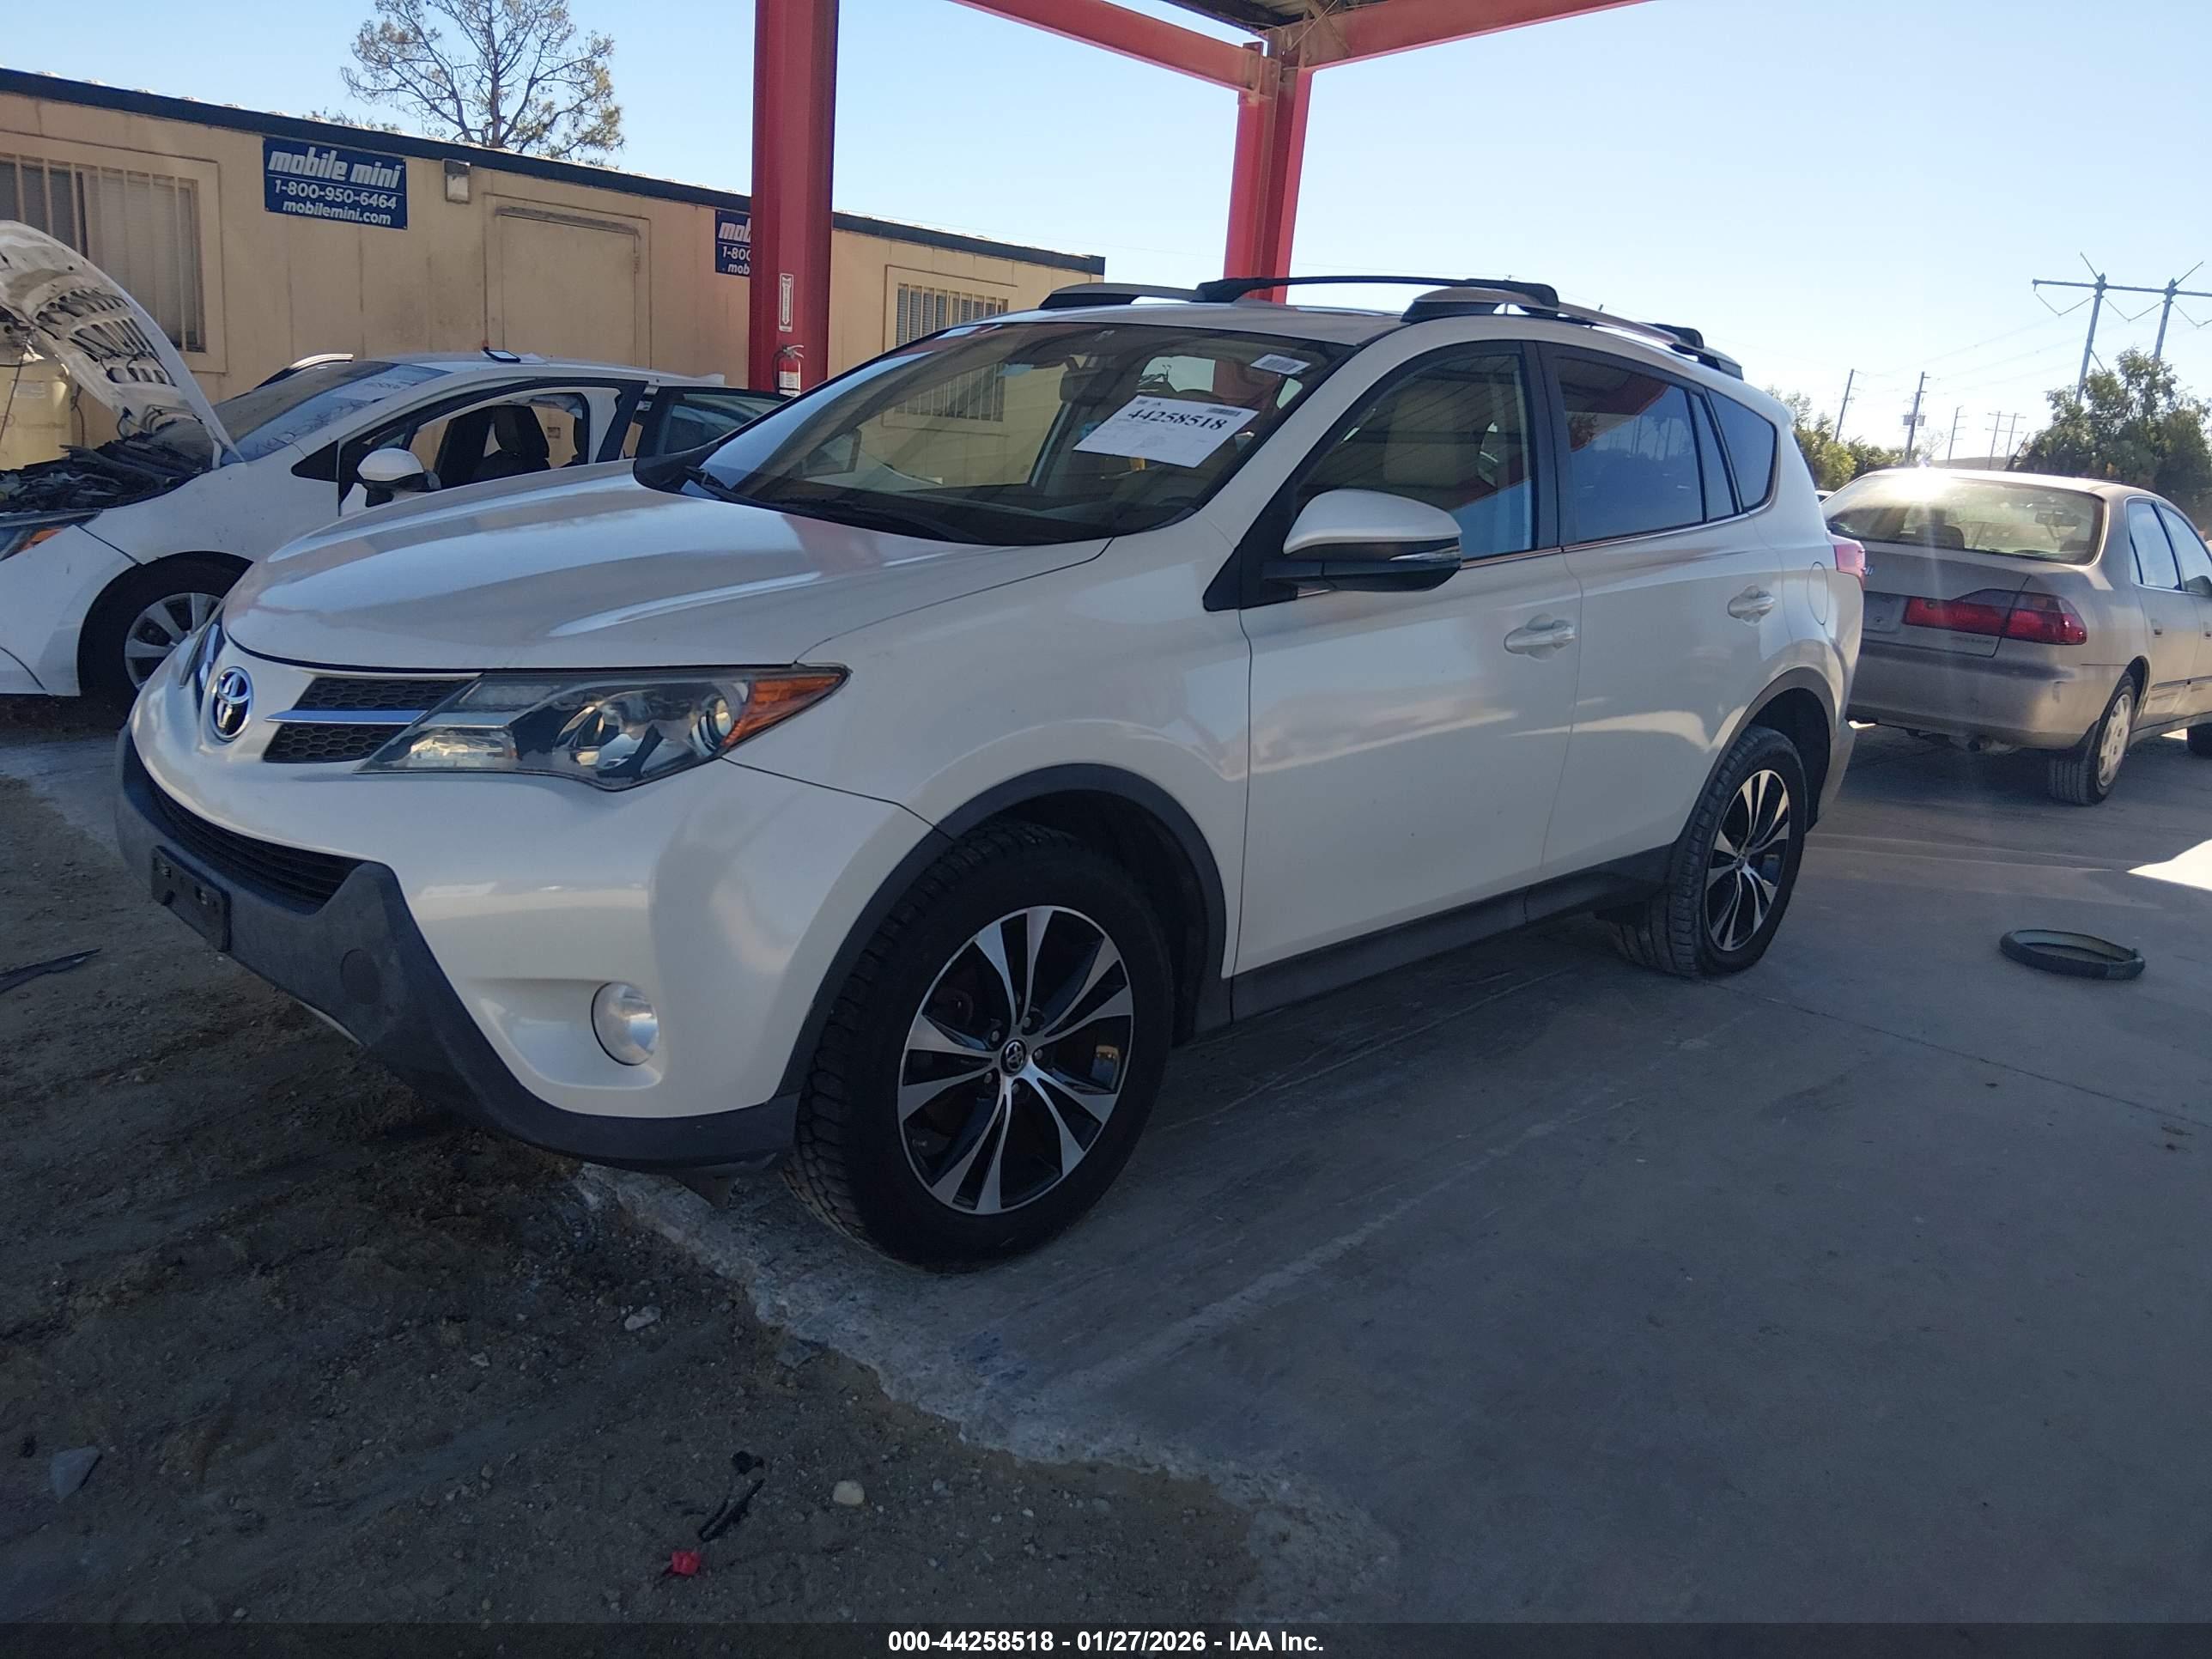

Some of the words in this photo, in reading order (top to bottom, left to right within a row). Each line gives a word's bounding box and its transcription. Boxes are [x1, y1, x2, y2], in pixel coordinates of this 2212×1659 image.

[268, 147, 348, 181] mobile
[349, 161, 402, 189] mini
[275, 179, 397, 210] 1-800-950-6464
[283, 200, 392, 225] mobilemini.com
[1127, 409, 1228, 430] 44258518
